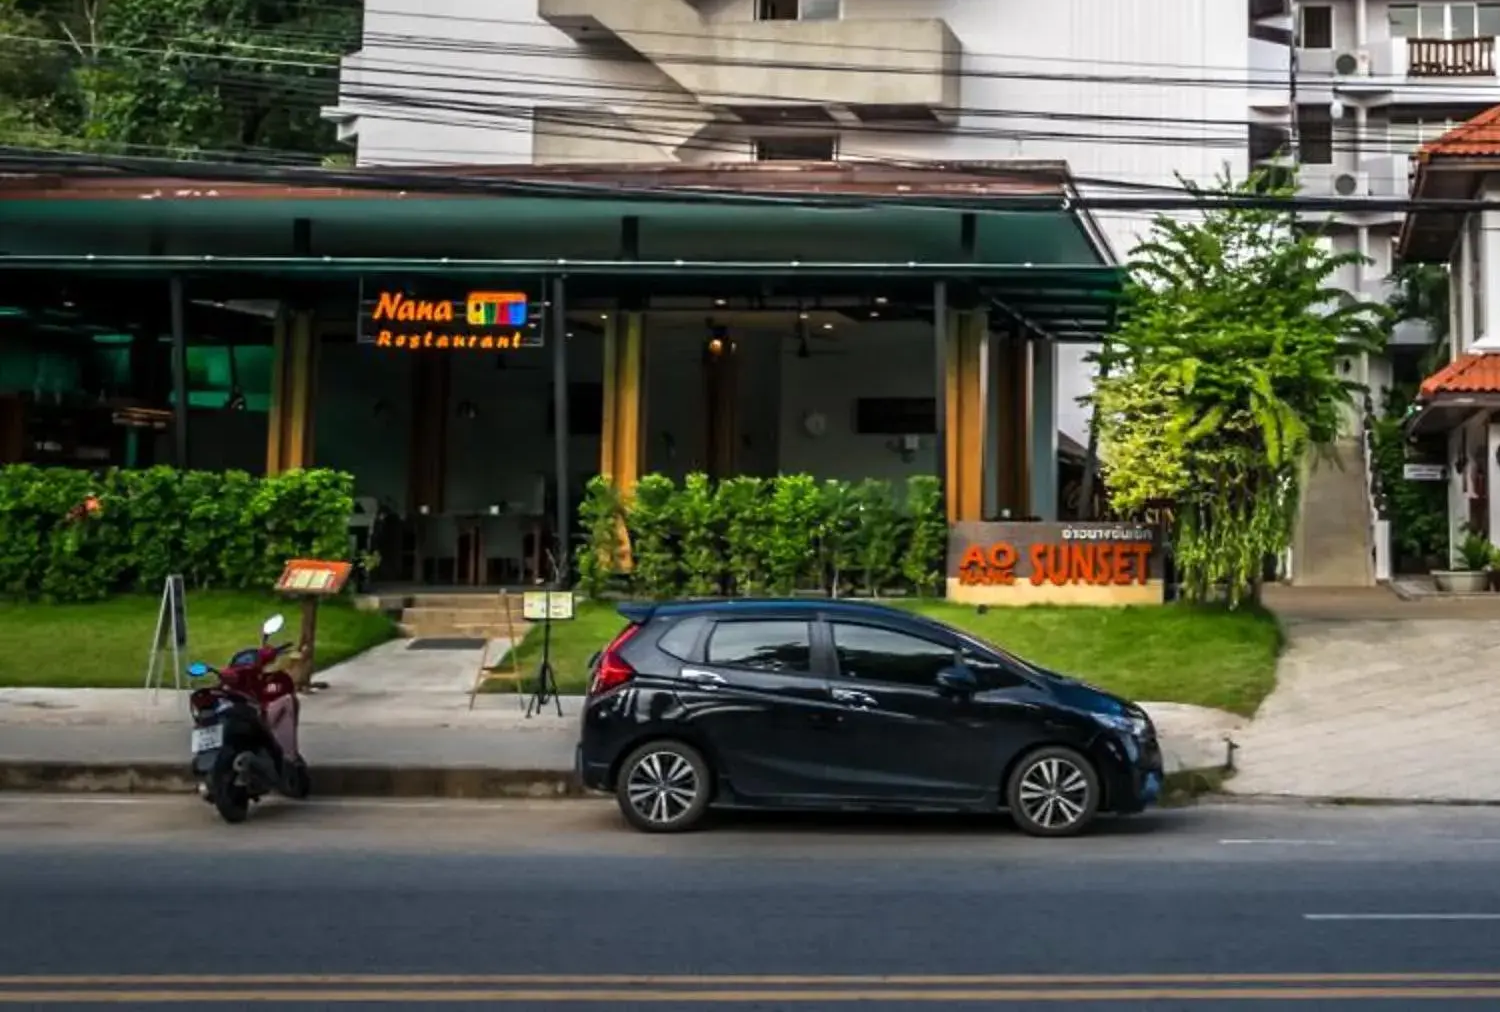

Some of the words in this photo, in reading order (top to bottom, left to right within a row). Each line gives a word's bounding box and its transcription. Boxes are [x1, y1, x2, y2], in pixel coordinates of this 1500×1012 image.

[372, 292, 453, 321] Nana
[376, 330, 522, 349] Restaurant
[960, 540, 1018, 571] AO
[1029, 542, 1152, 586] SUNSET
